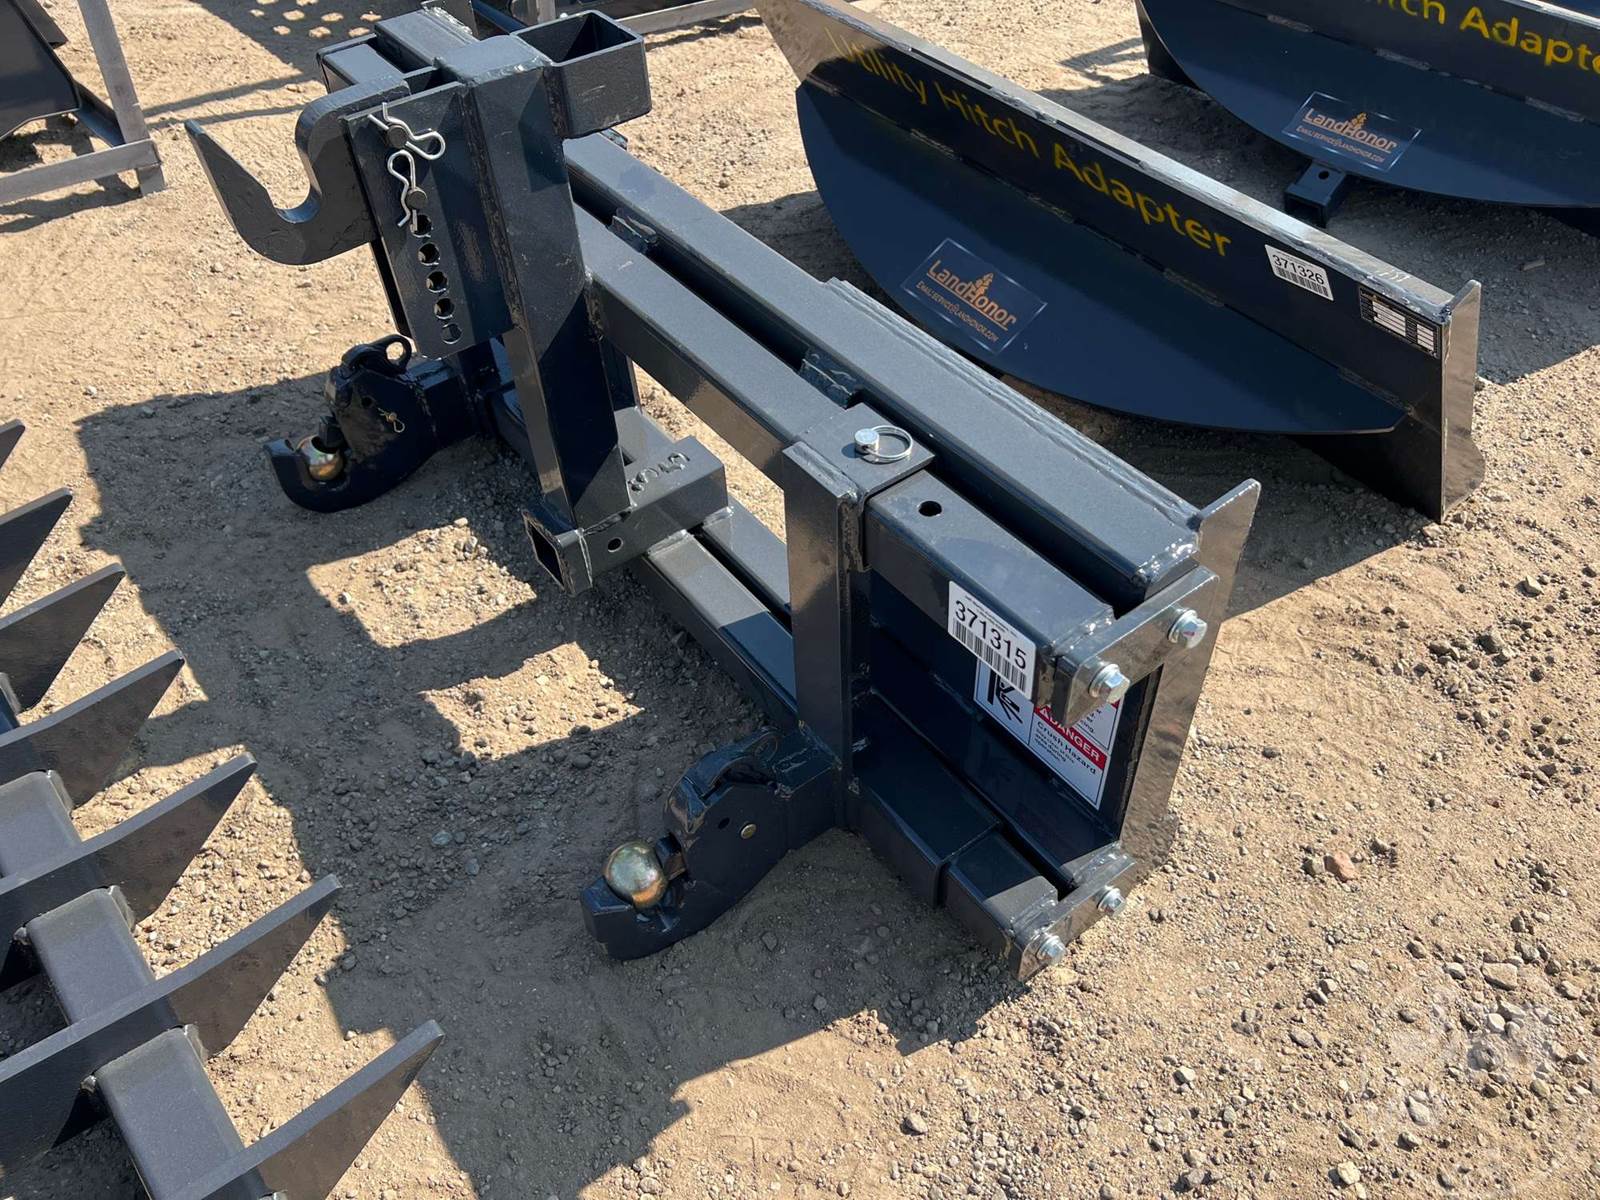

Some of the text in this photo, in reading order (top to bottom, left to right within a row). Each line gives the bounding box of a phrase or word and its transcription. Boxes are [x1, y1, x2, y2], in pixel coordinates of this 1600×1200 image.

[824, 26, 1232, 258] Utility Hitch Adapter
[1303, 107, 1398, 150] LandHonor
[927, 259, 1017, 327] LandHonor
[1272, 254, 1325, 285] 371326
[955, 600, 1027, 670] 371315
[1037, 721, 1064, 747] Crush
[1064, 744, 1097, 775] Hazard
